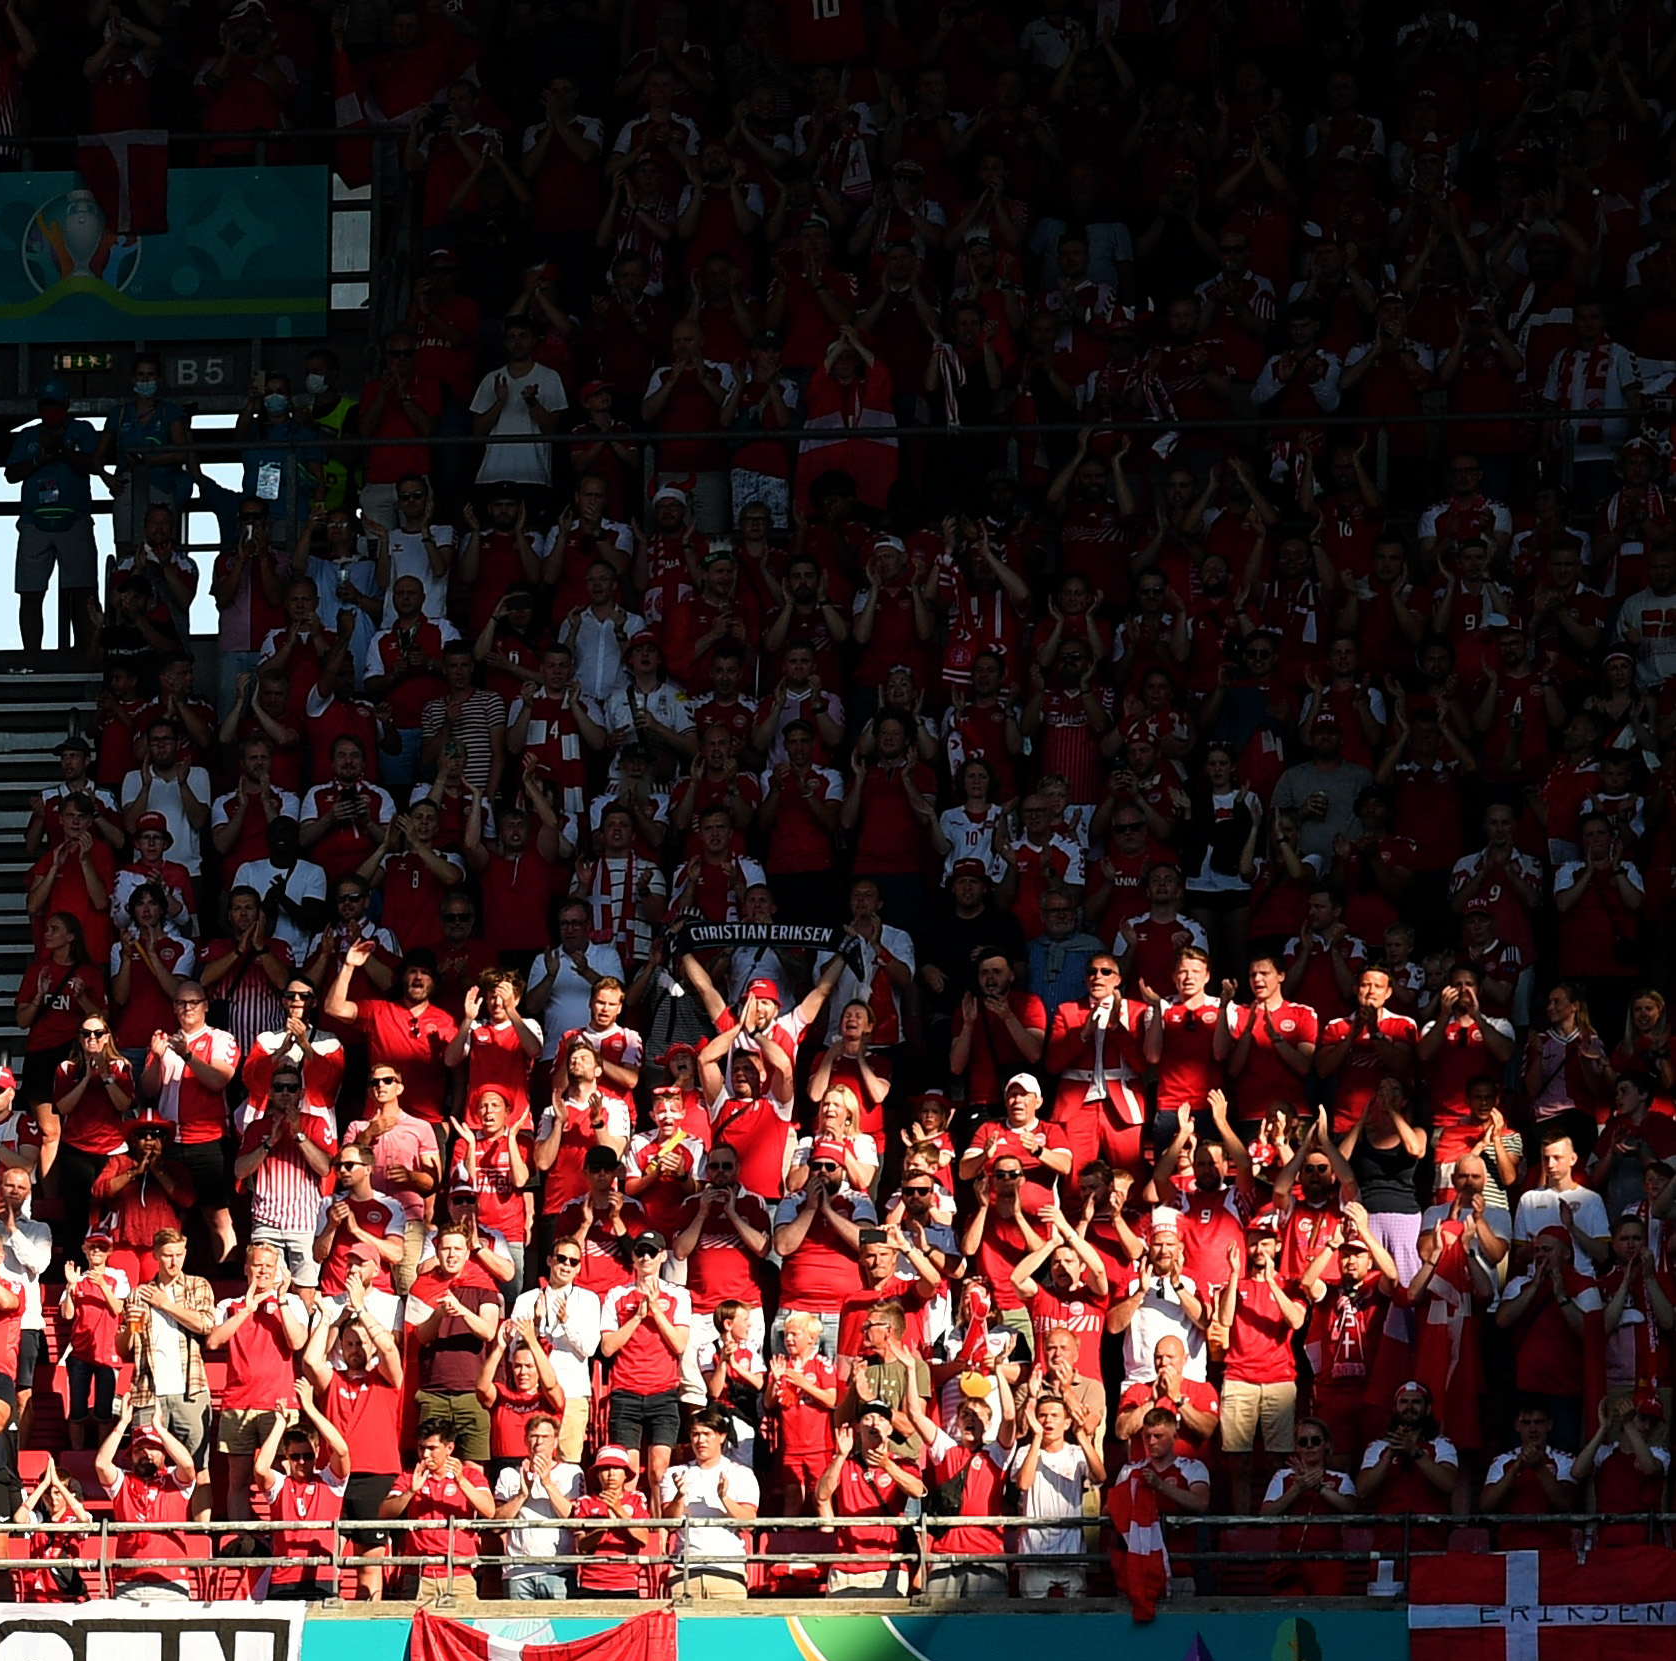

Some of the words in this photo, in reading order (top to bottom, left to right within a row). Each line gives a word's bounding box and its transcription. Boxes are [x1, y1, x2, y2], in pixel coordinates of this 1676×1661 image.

[1339, 520, 1353, 538] 16
[1465, 614, 1476, 631] 9
[549, 720, 560, 740] 4
[965, 831, 978, 846] 10
[412, 871, 420, 888] 8
[1489, 885, 1501, 902] 9
[690, 924, 767, 942] CHRISTIAN
[771, 925, 833, 943] ERIKSEN
[1201, 1209, 1212, 1224] 9
